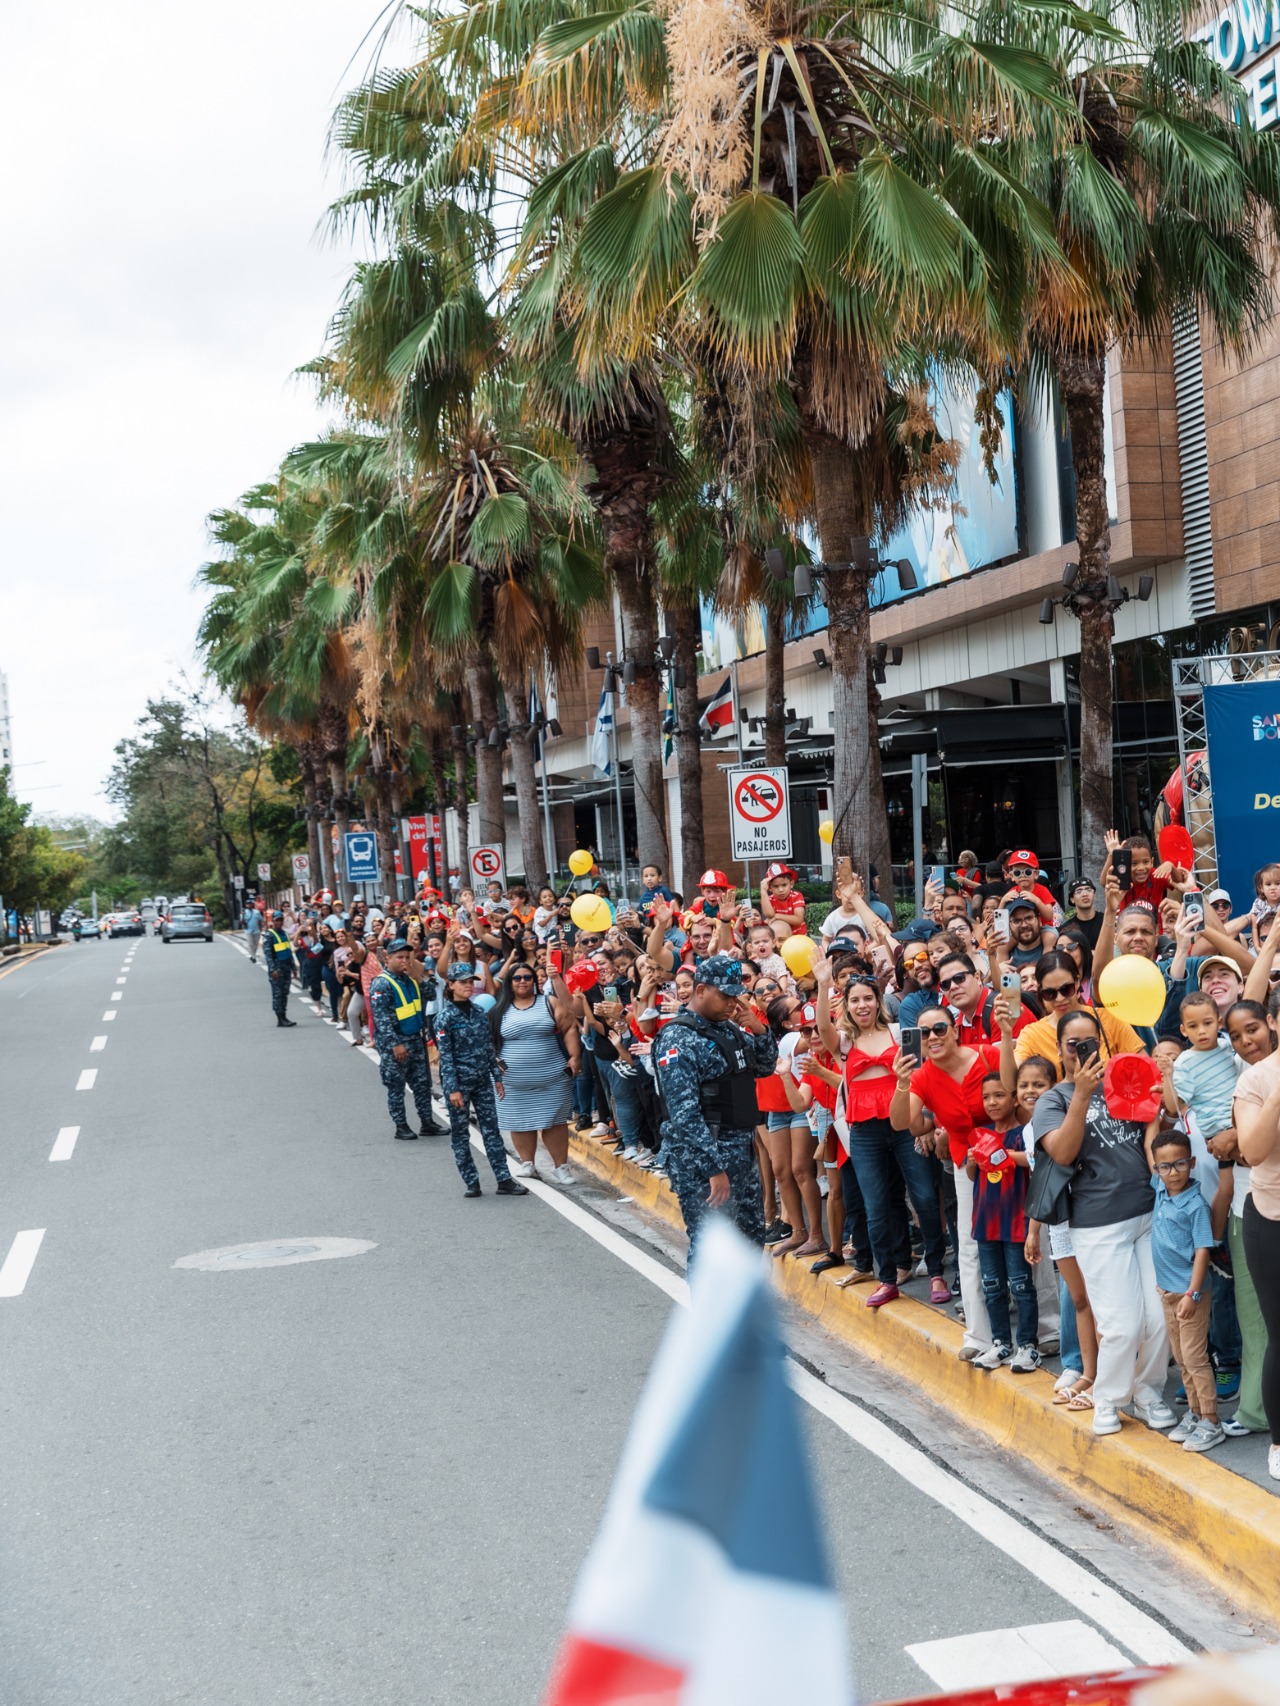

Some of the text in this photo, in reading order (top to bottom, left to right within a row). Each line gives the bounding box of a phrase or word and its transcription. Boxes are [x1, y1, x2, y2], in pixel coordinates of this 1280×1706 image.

[754, 827, 767, 838] NO
[737, 840, 787, 852] PASAJEROS
[726, 961, 742, 976] POL
